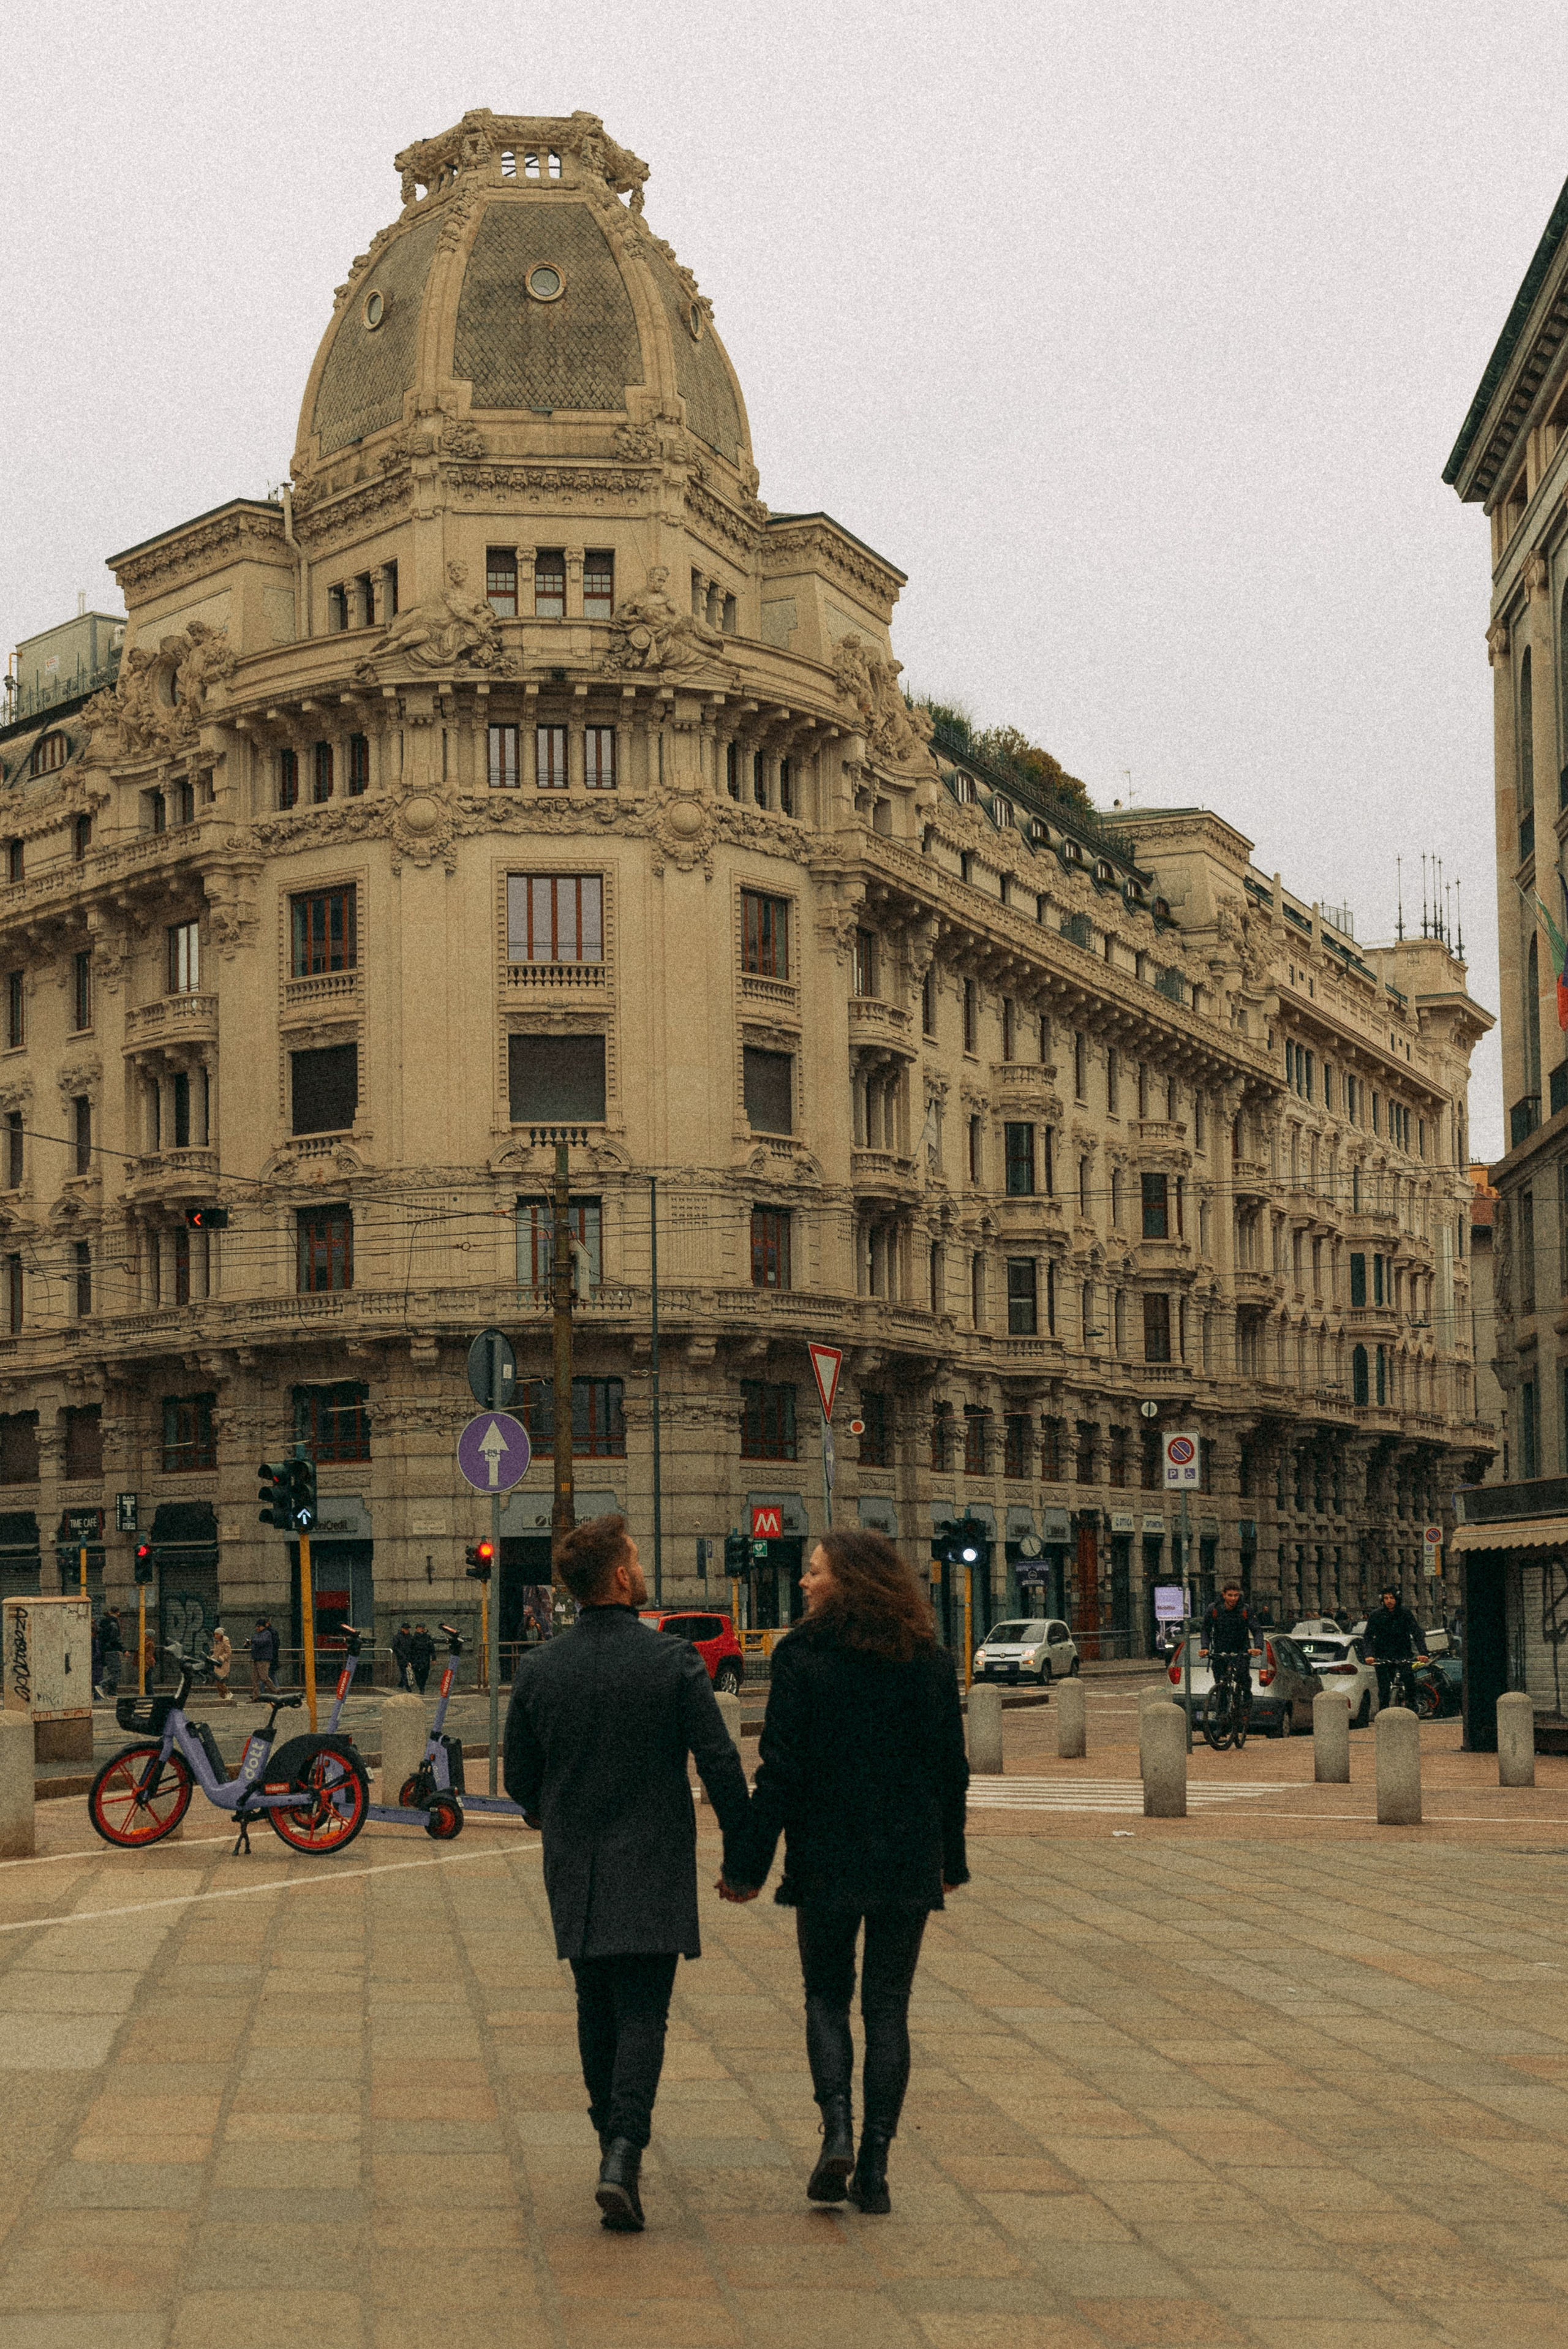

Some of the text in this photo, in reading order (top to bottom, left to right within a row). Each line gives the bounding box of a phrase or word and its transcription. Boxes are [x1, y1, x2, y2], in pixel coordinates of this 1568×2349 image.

[123, 1500, 135, 1517] T
[70, 1518, 83, 1528] TIME
[755, 1513, 778, 1532] M
[244, 1742, 265, 1780] dott
